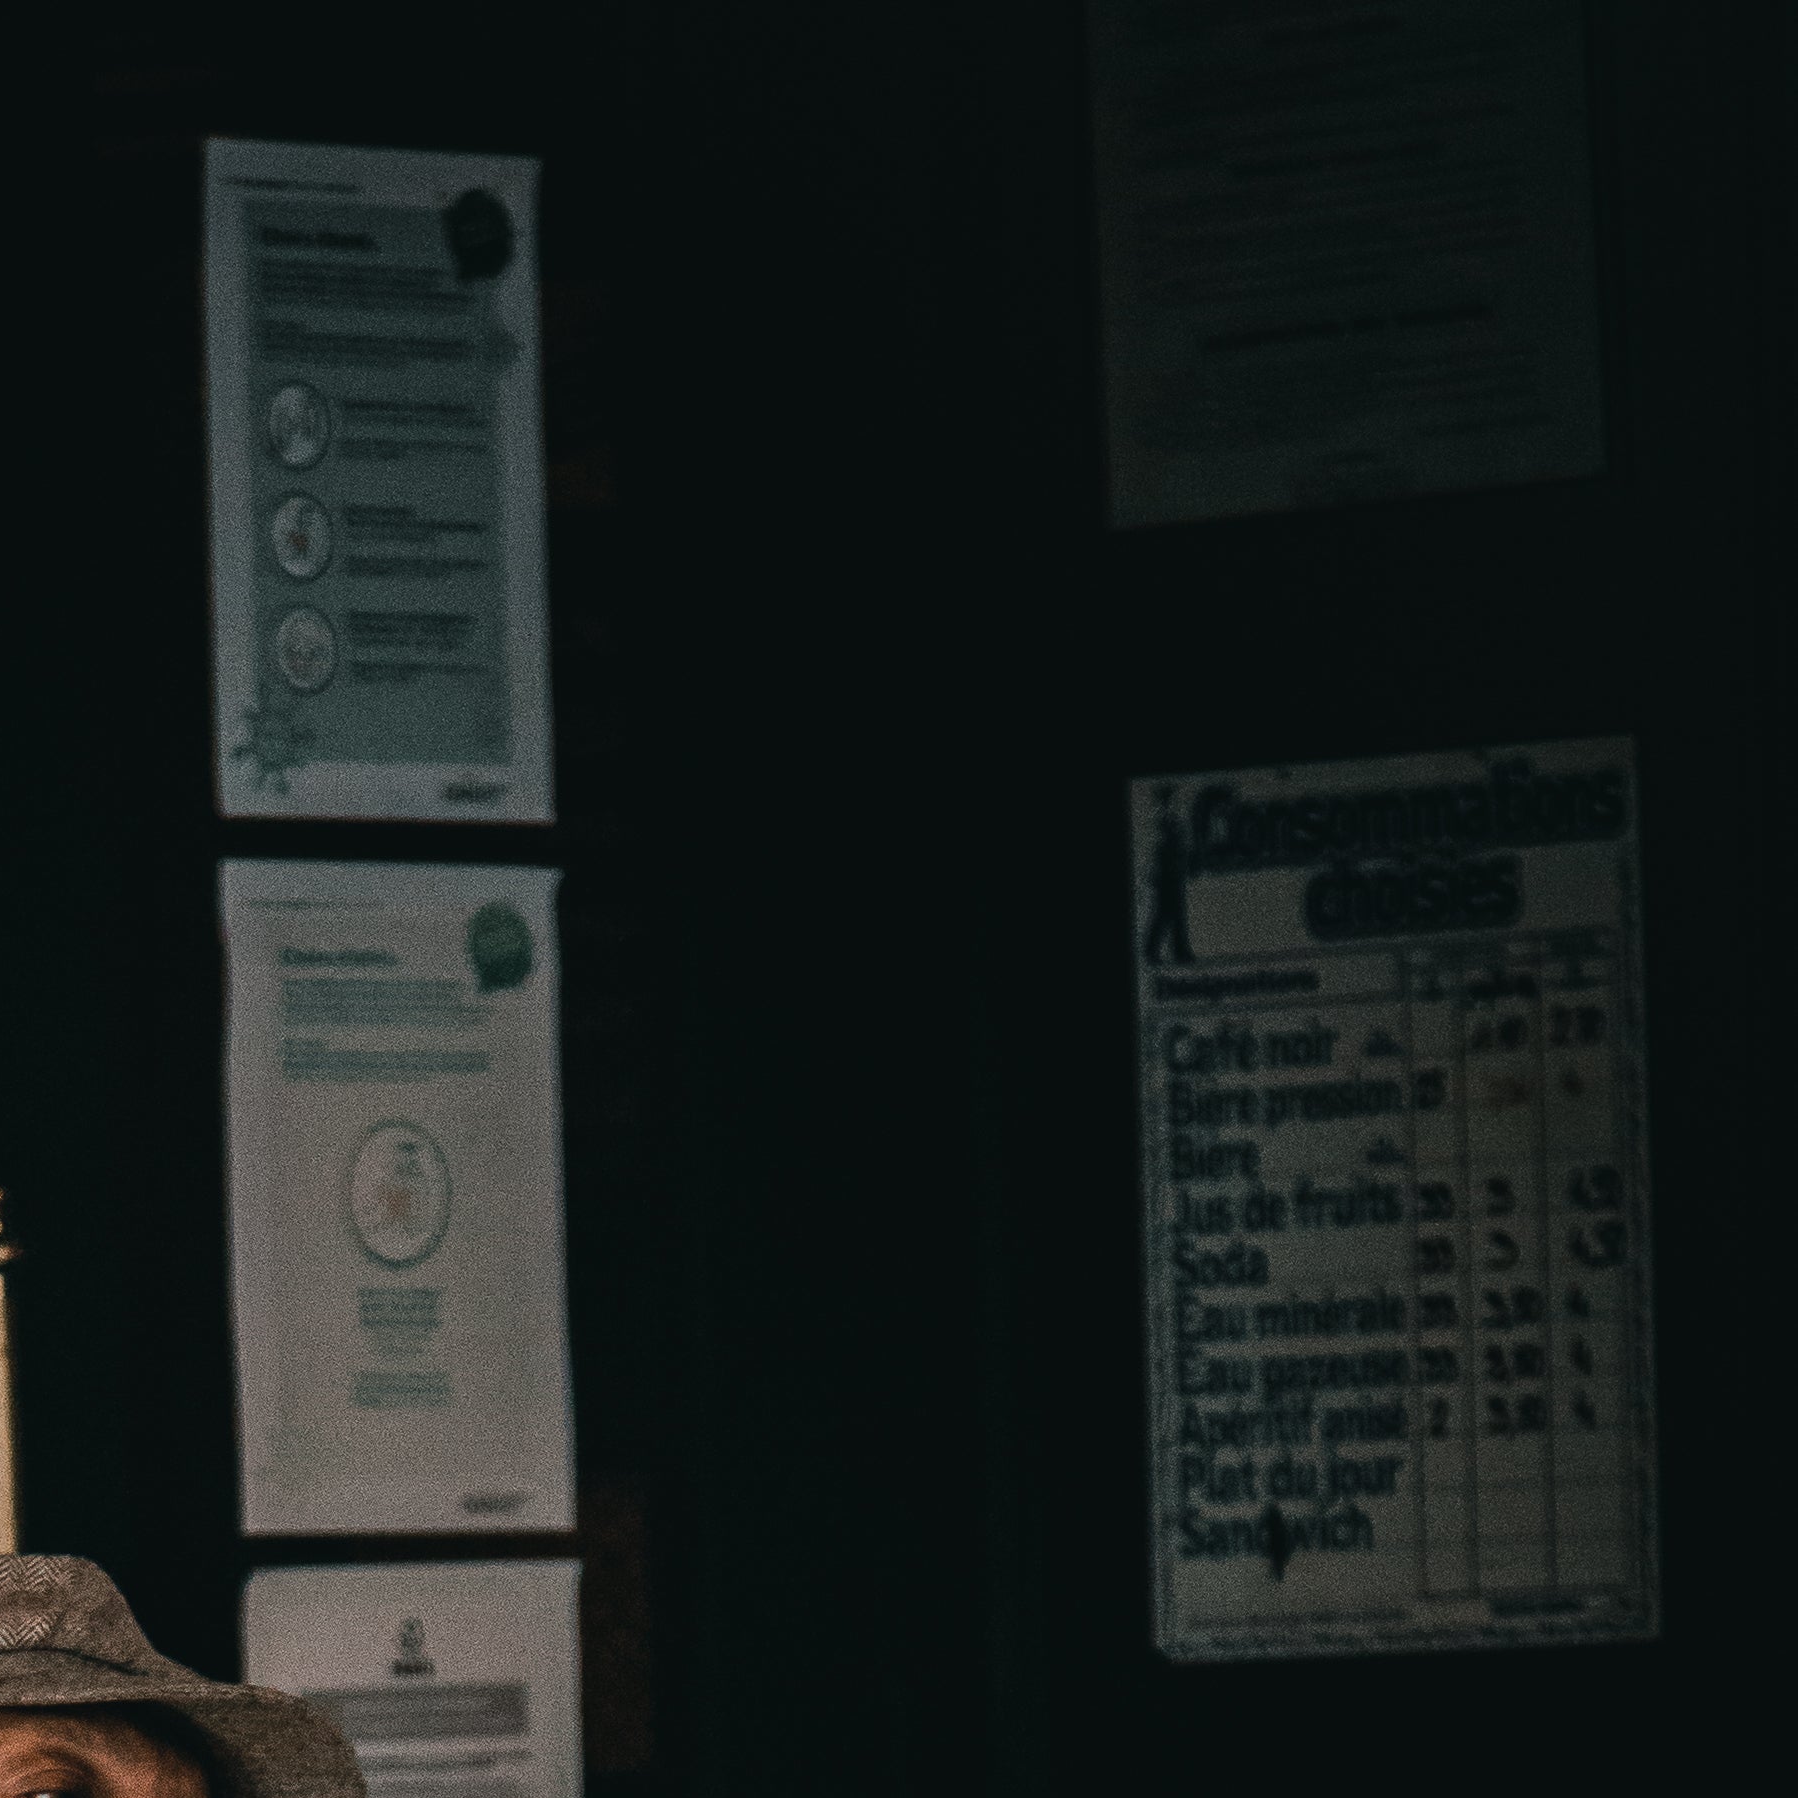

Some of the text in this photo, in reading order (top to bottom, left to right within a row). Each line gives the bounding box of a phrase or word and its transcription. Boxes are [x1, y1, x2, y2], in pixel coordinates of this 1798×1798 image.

[1190, 756, 1628, 872] Consommations
[1306, 850, 1523, 940] choisies
[1167, 1017, 1338, 1074] Café noir
[1264, 1076, 1404, 1128] pression
[1172, 1189, 1234, 1236] Jus
[1242, 1182, 1287, 1232] de
[1293, 1175, 1404, 1227] fruits
[1173, 1240, 1270, 1287] Soda
[1176, 1293, 1248, 1342] Eau
[1255, 1290, 1406, 1336] minérale
[1178, 1345, 1252, 1395] Eau
[1263, 1350, 1409, 1404] gazeuse
[1180, 1396, 1314, 1450] Apéritif
[1180, 1452, 1404, 1508] Plat du jour
